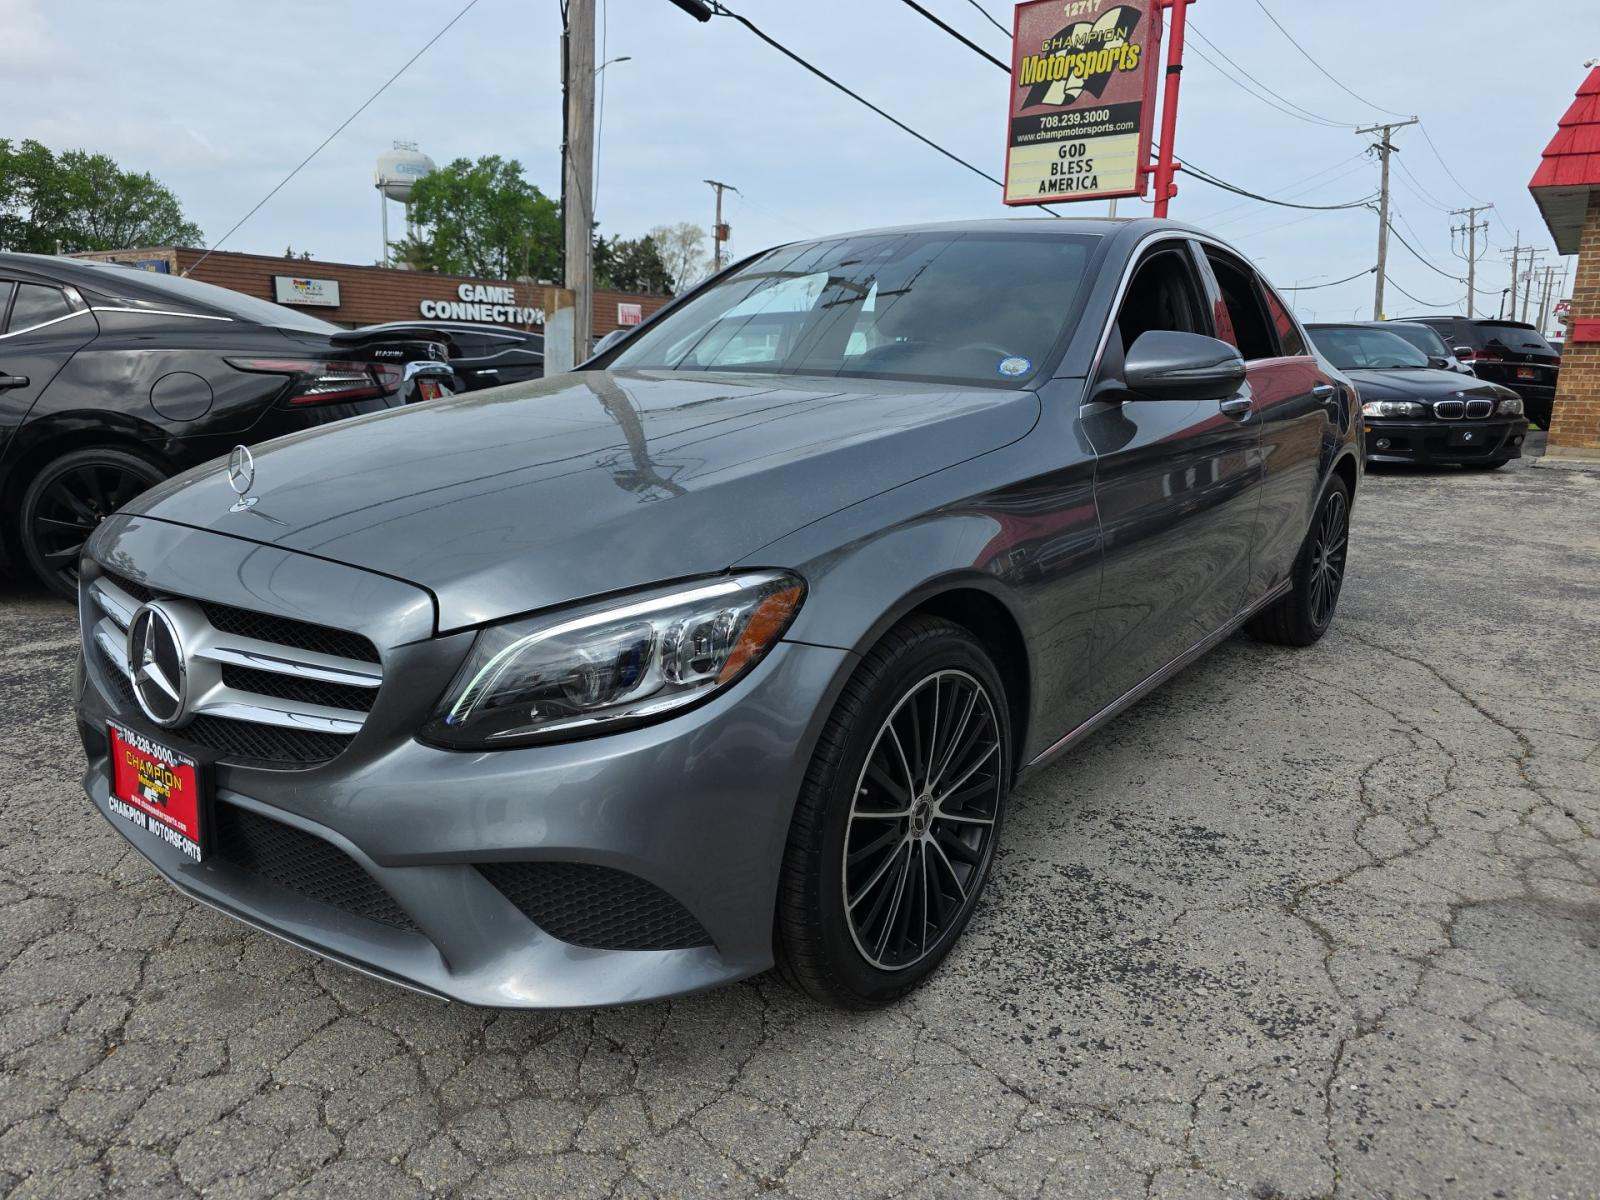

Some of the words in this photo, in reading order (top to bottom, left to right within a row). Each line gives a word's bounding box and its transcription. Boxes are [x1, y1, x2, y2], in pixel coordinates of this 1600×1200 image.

[1063, 0, 1100, 17] 12717
[1041, 26, 1128, 52] CHAMPION
[1019, 42, 1142, 86] Motorsports
[1040, 109, 1110, 129] 708.239.3000
[1017, 121, 1134, 142] www.champmotorsports.com
[1058, 143, 1086, 159] GOD
[1051, 158, 1093, 176] BLESS
[1038, 175, 1098, 194] AMERICA
[458, 283, 515, 304] GAME
[126, 751, 183, 791] CHAMPION
[109, 796, 146, 828] CHAMPION
